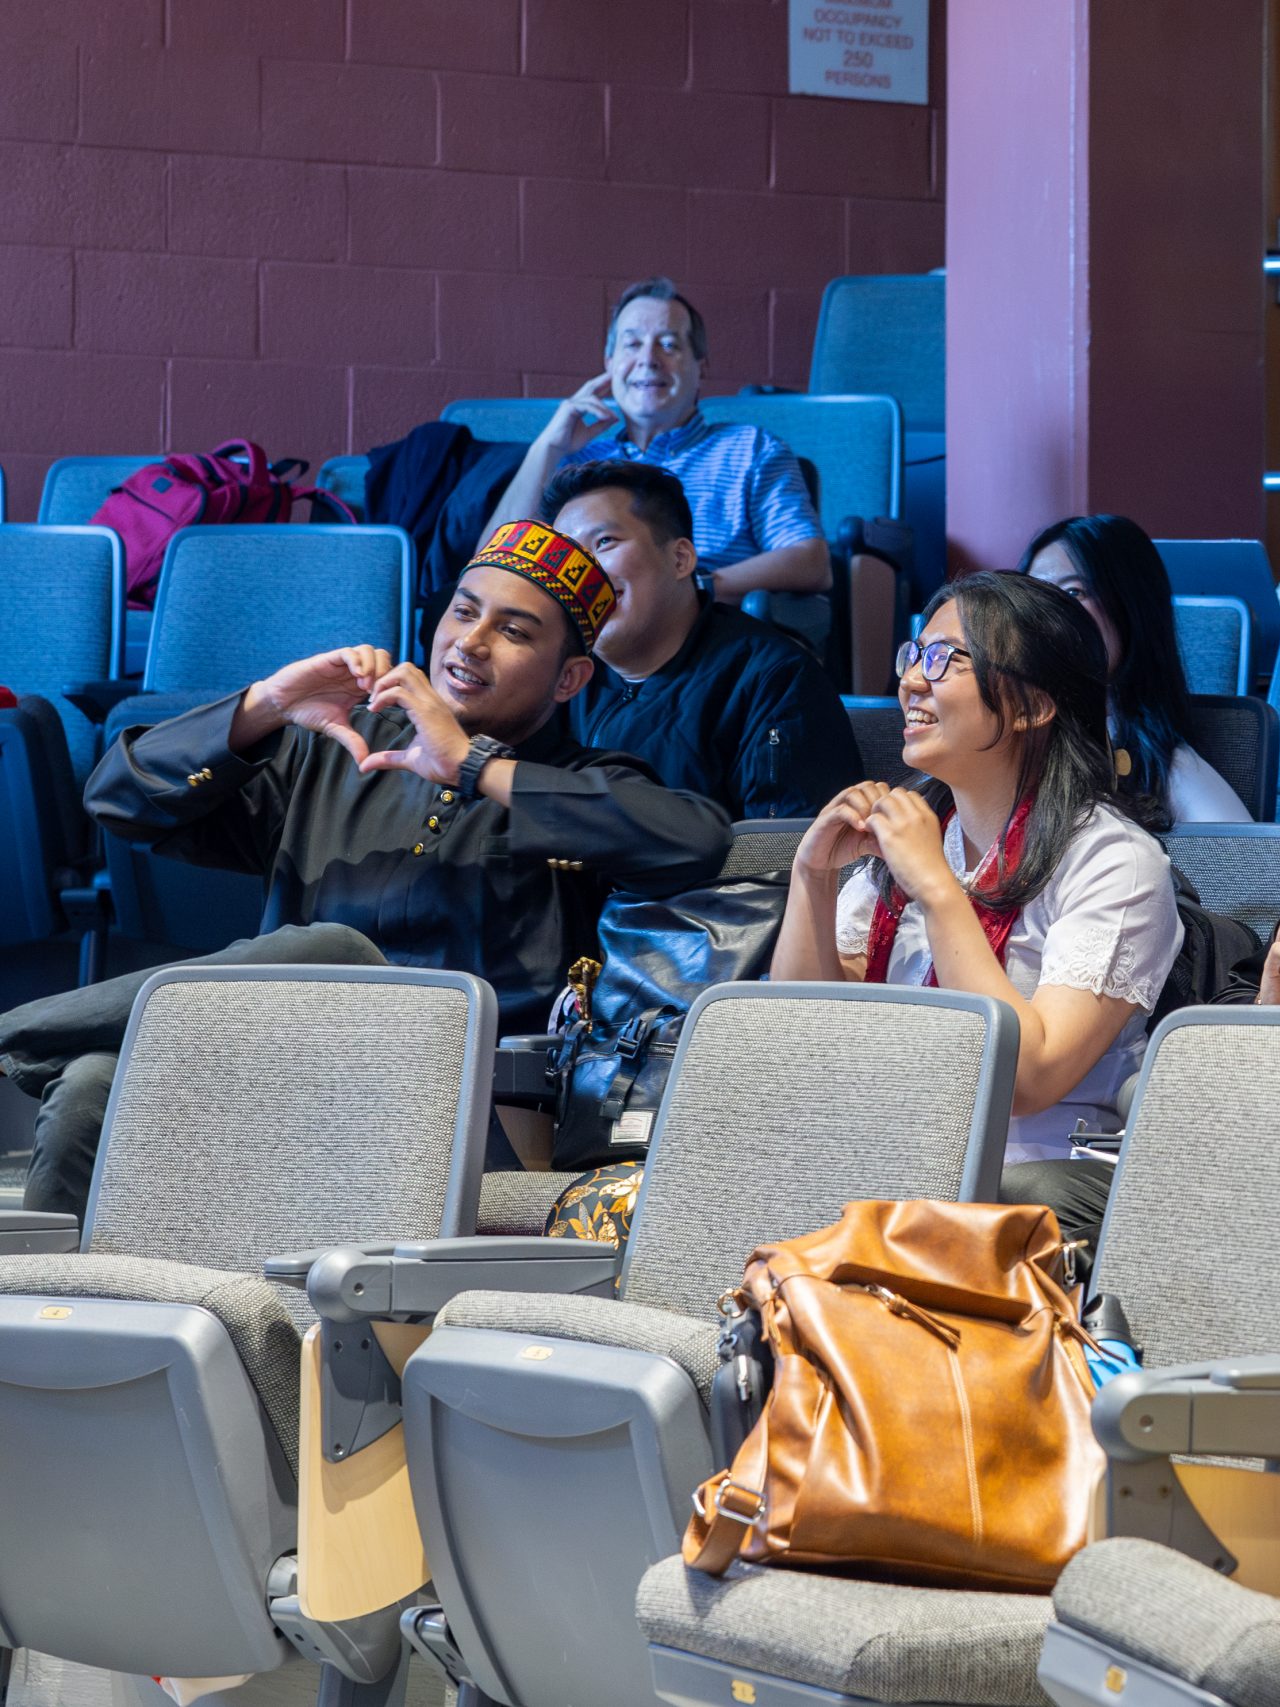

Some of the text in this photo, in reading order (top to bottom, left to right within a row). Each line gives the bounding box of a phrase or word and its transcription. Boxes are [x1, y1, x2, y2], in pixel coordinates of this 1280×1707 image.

[814, 8, 903, 28] OCCUPANCY
[803, 27, 914, 50] NOT TO EXCEED
[843, 49, 874, 68] 250
[825, 70, 892, 89] PERSONS
